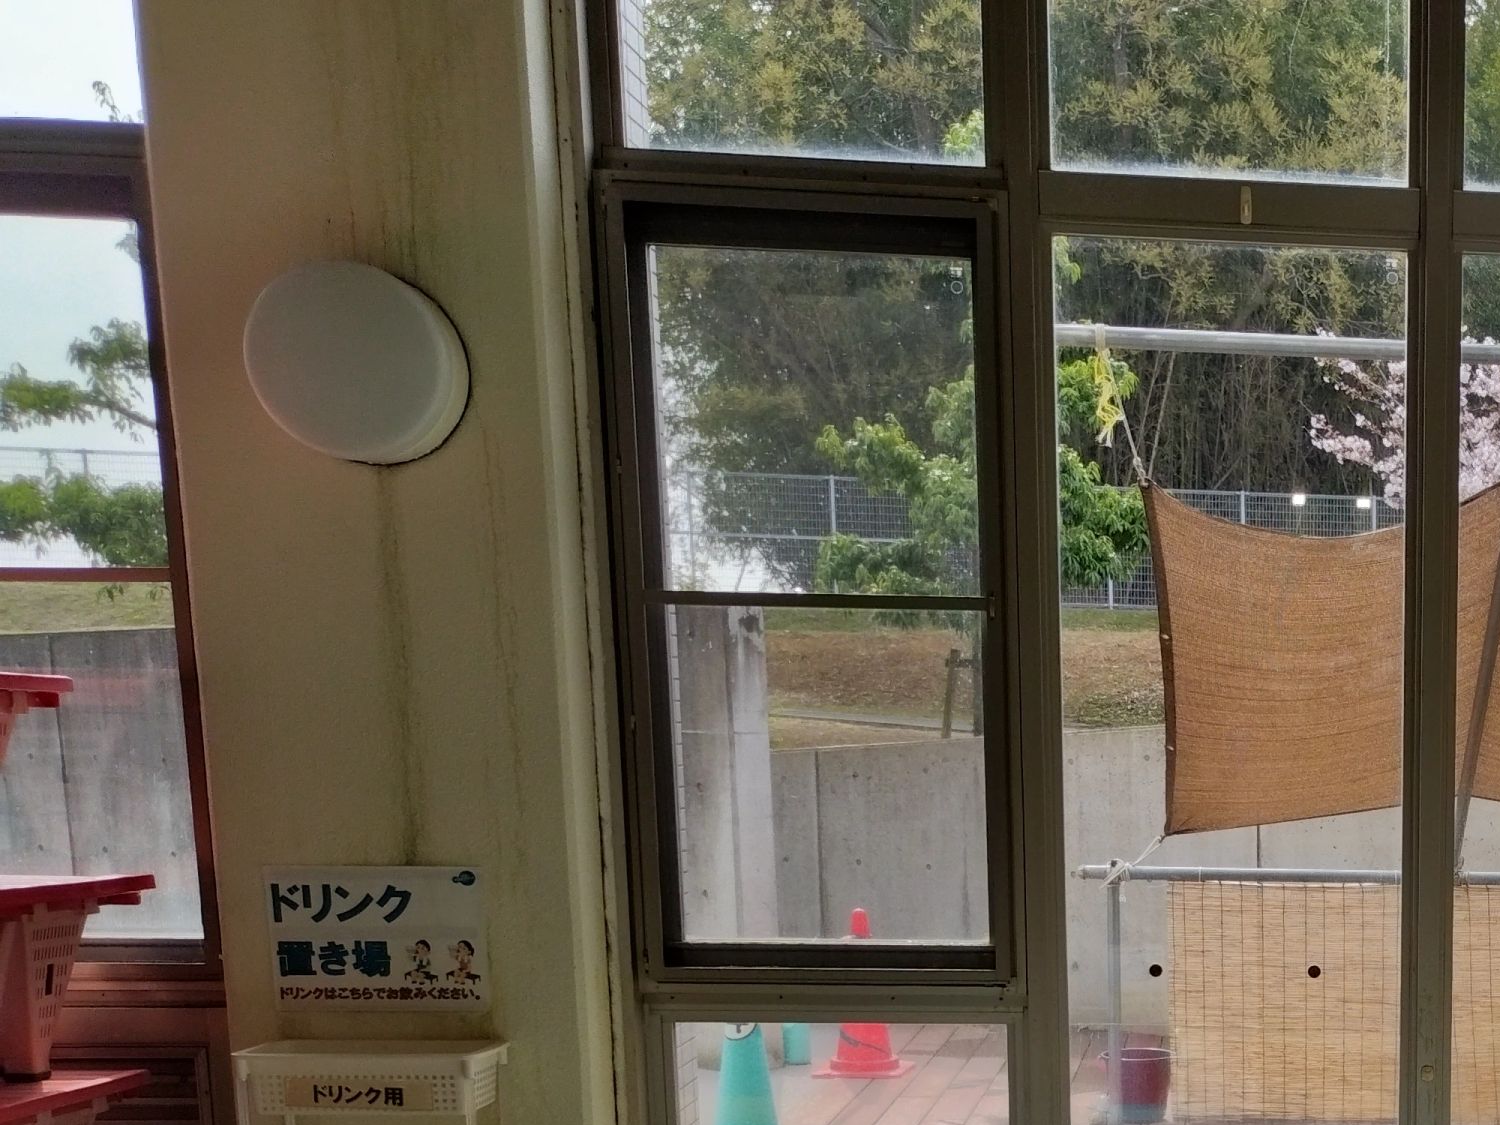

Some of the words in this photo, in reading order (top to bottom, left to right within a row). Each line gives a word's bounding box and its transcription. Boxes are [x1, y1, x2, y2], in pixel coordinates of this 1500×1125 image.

[270, 883, 412, 923] ドリンク
[276, 940, 391, 977] 置き場
[313, 1085, 403, 1106] ドリンク用
